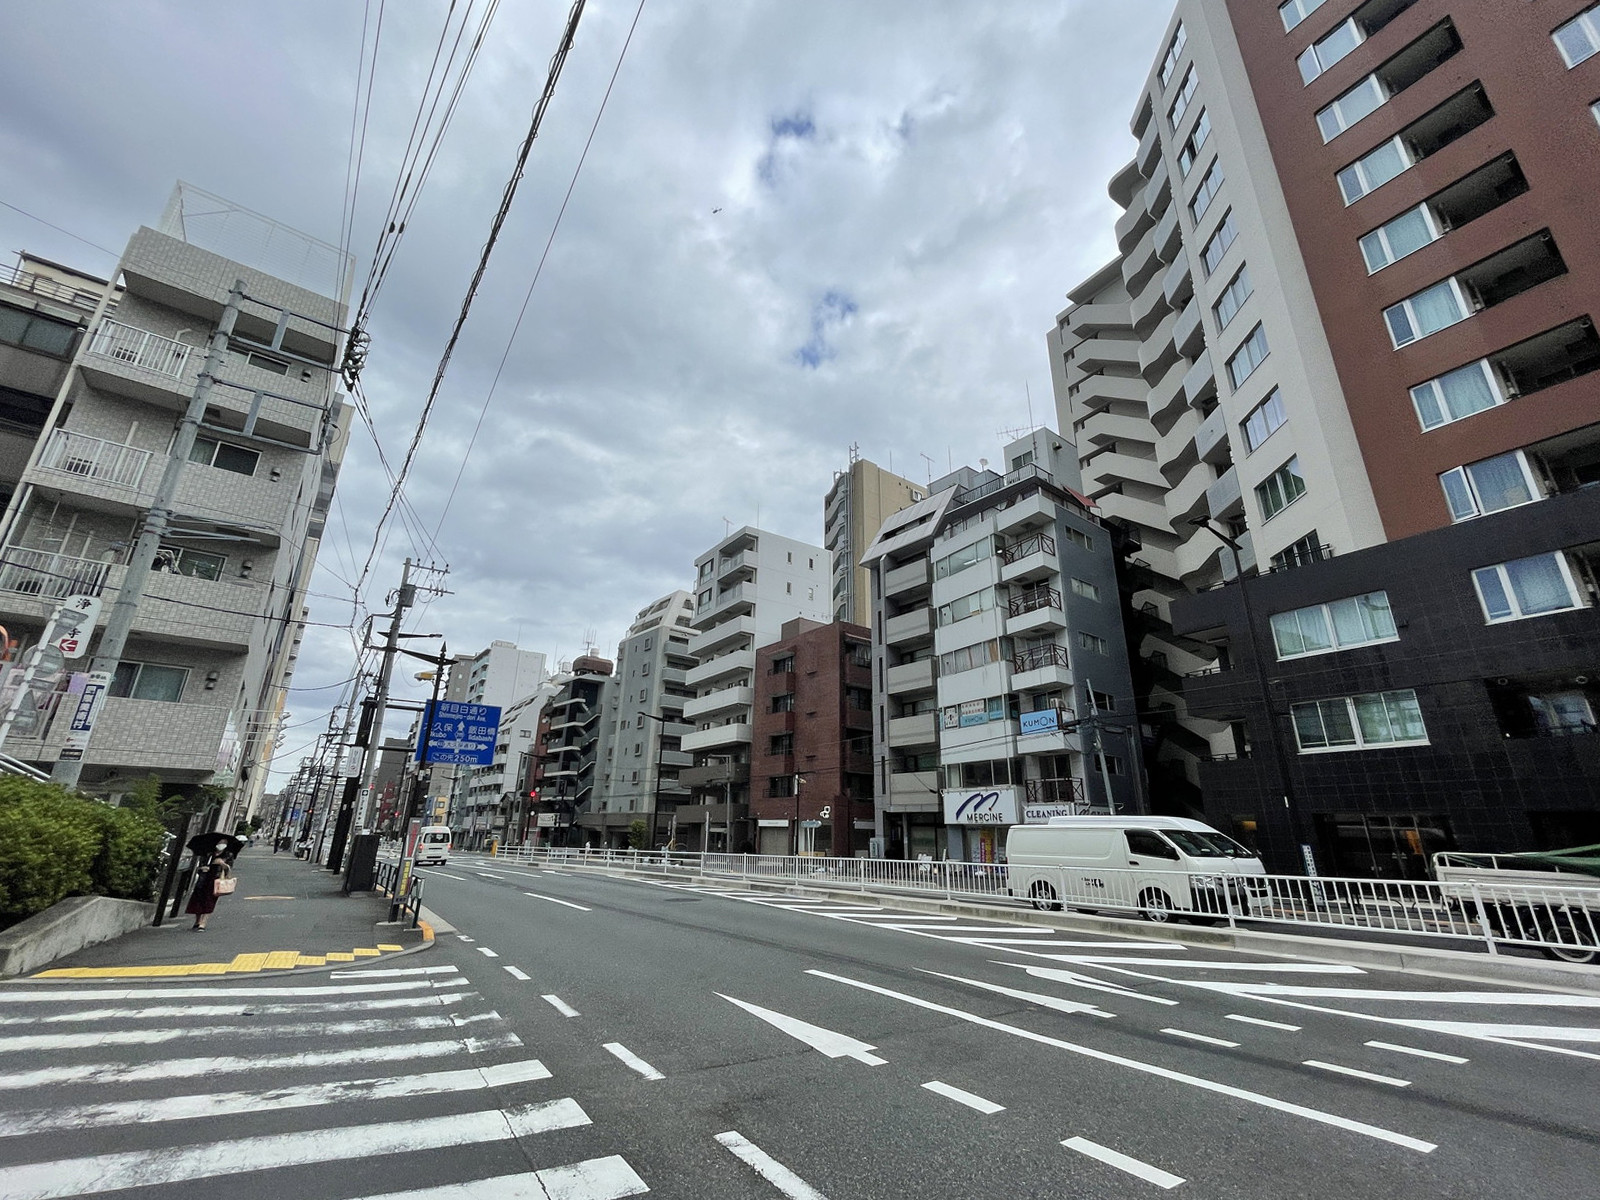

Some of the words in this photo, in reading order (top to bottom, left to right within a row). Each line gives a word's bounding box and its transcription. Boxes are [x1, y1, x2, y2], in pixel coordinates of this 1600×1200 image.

[441, 703, 487, 715] 新目白通り
[1023, 716, 1055, 728] KUMON
[468, 726, 496, 735] 飯田橋
[966, 812, 1003, 823] MERCINE
[1026, 809, 1067, 818] CLEANING
